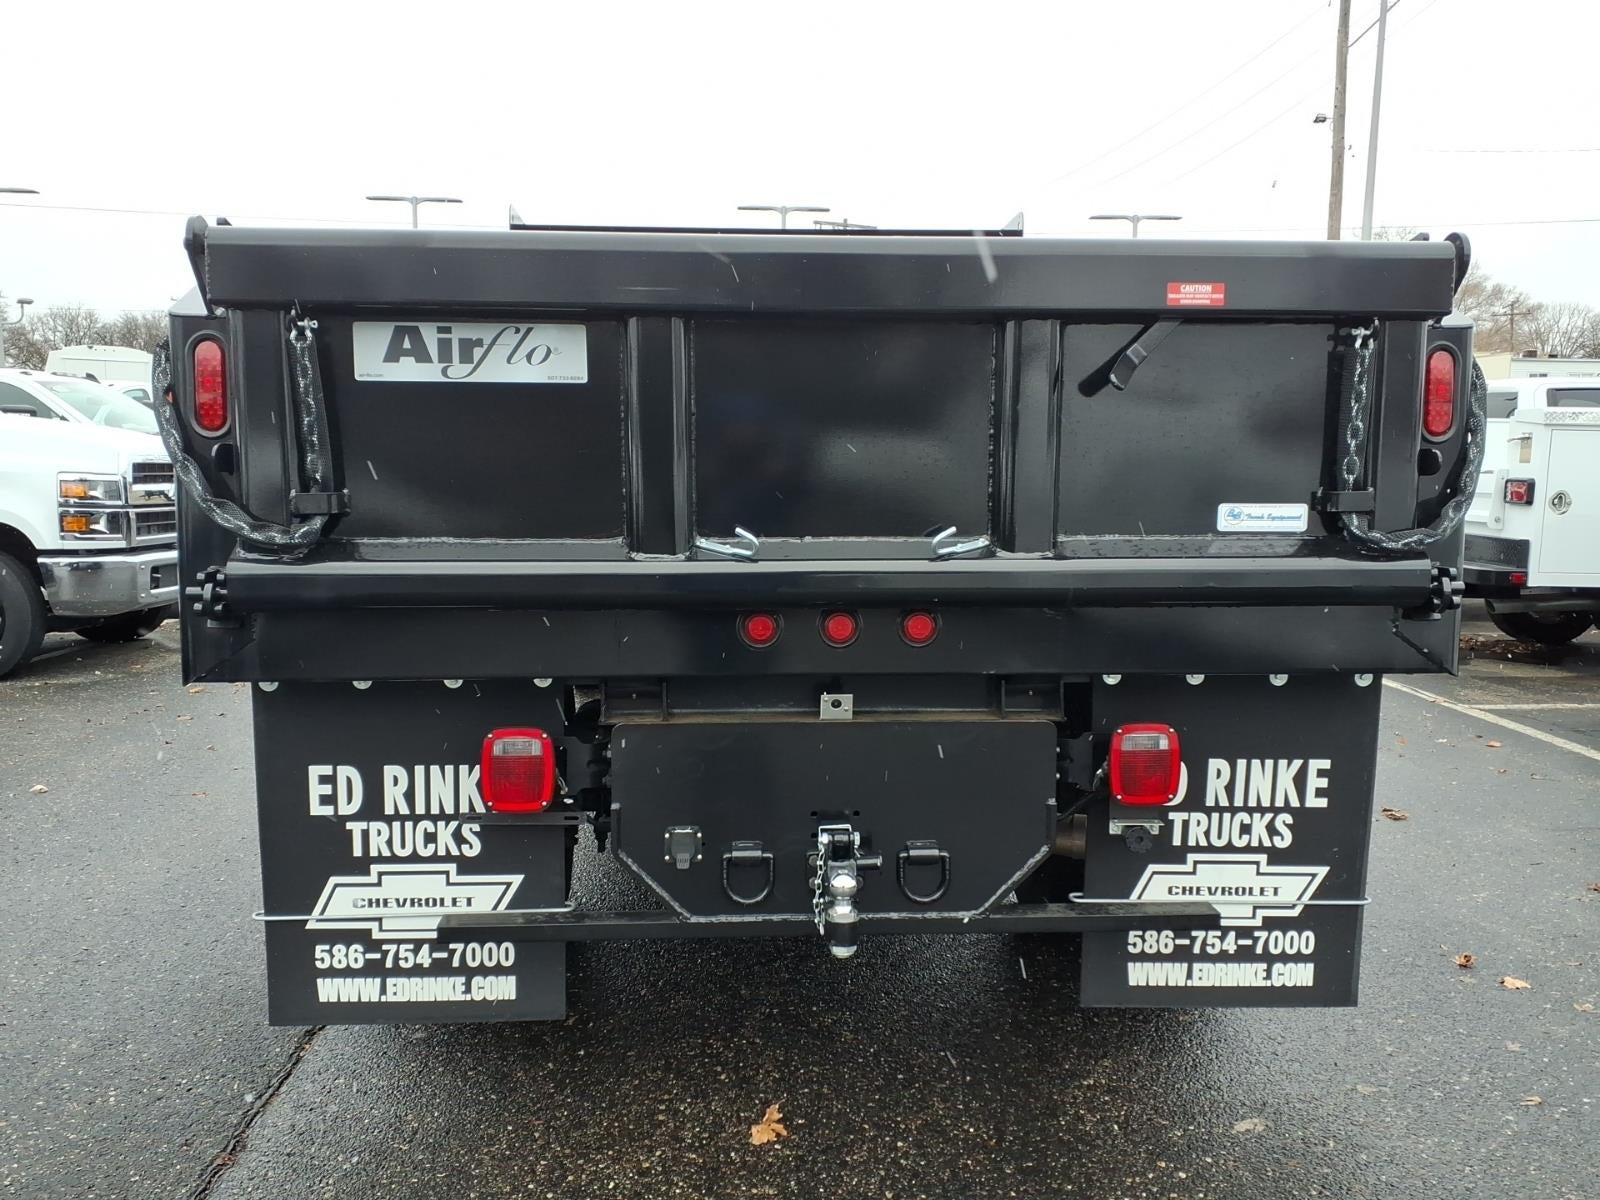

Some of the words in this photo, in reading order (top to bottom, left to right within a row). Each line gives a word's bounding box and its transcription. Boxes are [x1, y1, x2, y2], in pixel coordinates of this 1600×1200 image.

[1180, 284, 1212, 293] CAUTION
[382, 324, 562, 380] Airflo
[1266, 512, 1303, 522] Equipment
[308, 765, 364, 816] ED
[384, 764, 488, 815] RINK
[1205, 758, 1332, 808] RINKE
[346, 820, 482, 858] TRUCKS
[1168, 811, 1294, 848] TRUCKS
[352, 896, 475, 909] CHEVROLET
[1167, 885, 1282, 897] CHEVROLET
[314, 942, 516, 970] 586-754-7000
[1127, 930, 1316, 955] 586-754-7000
[316, 975, 517, 1003] WWW.EDRINKE.COM
[1127, 962, 1315, 988] WWW.EDRINKE.COM
